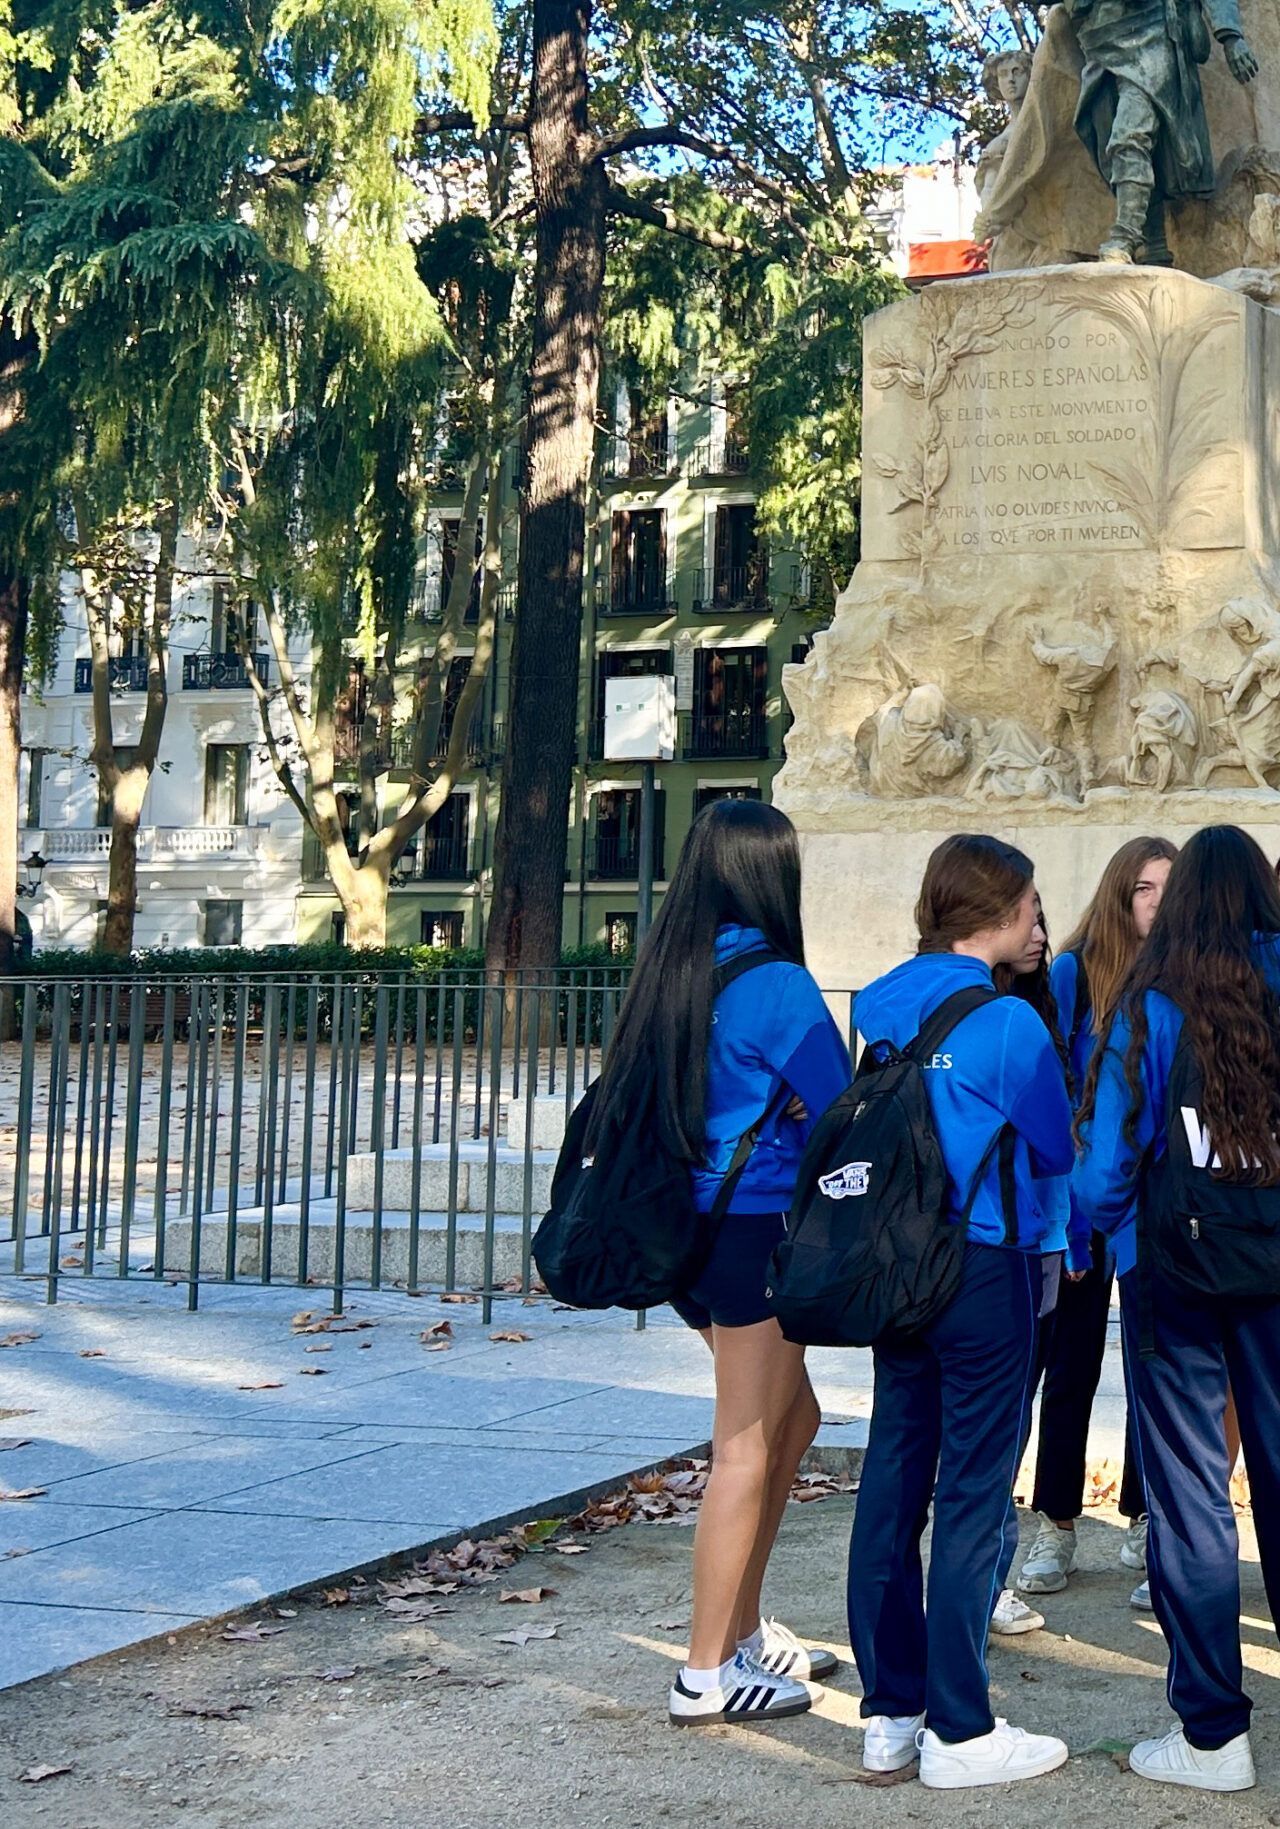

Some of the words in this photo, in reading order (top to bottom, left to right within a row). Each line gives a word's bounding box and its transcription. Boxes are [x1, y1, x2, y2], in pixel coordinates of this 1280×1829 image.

[1086, 332, 1117, 347] POR
[1043, 362, 1148, 386] ESPAÑOLAS
[1009, 404, 1045, 419] ESTE
[953, 435, 970, 449] LA
[1035, 431, 1061, 445] DEL
[1067, 427, 1136, 444] SOLDADO
[1018, 462, 1085, 481] NOVAL
[985, 503, 1008, 518] NO
[1013, 501, 1070, 516] OLVIDES
[953, 532, 980, 546] LOS
[1028, 528, 1056, 543] POR
[1061, 527, 1073, 542] TI
